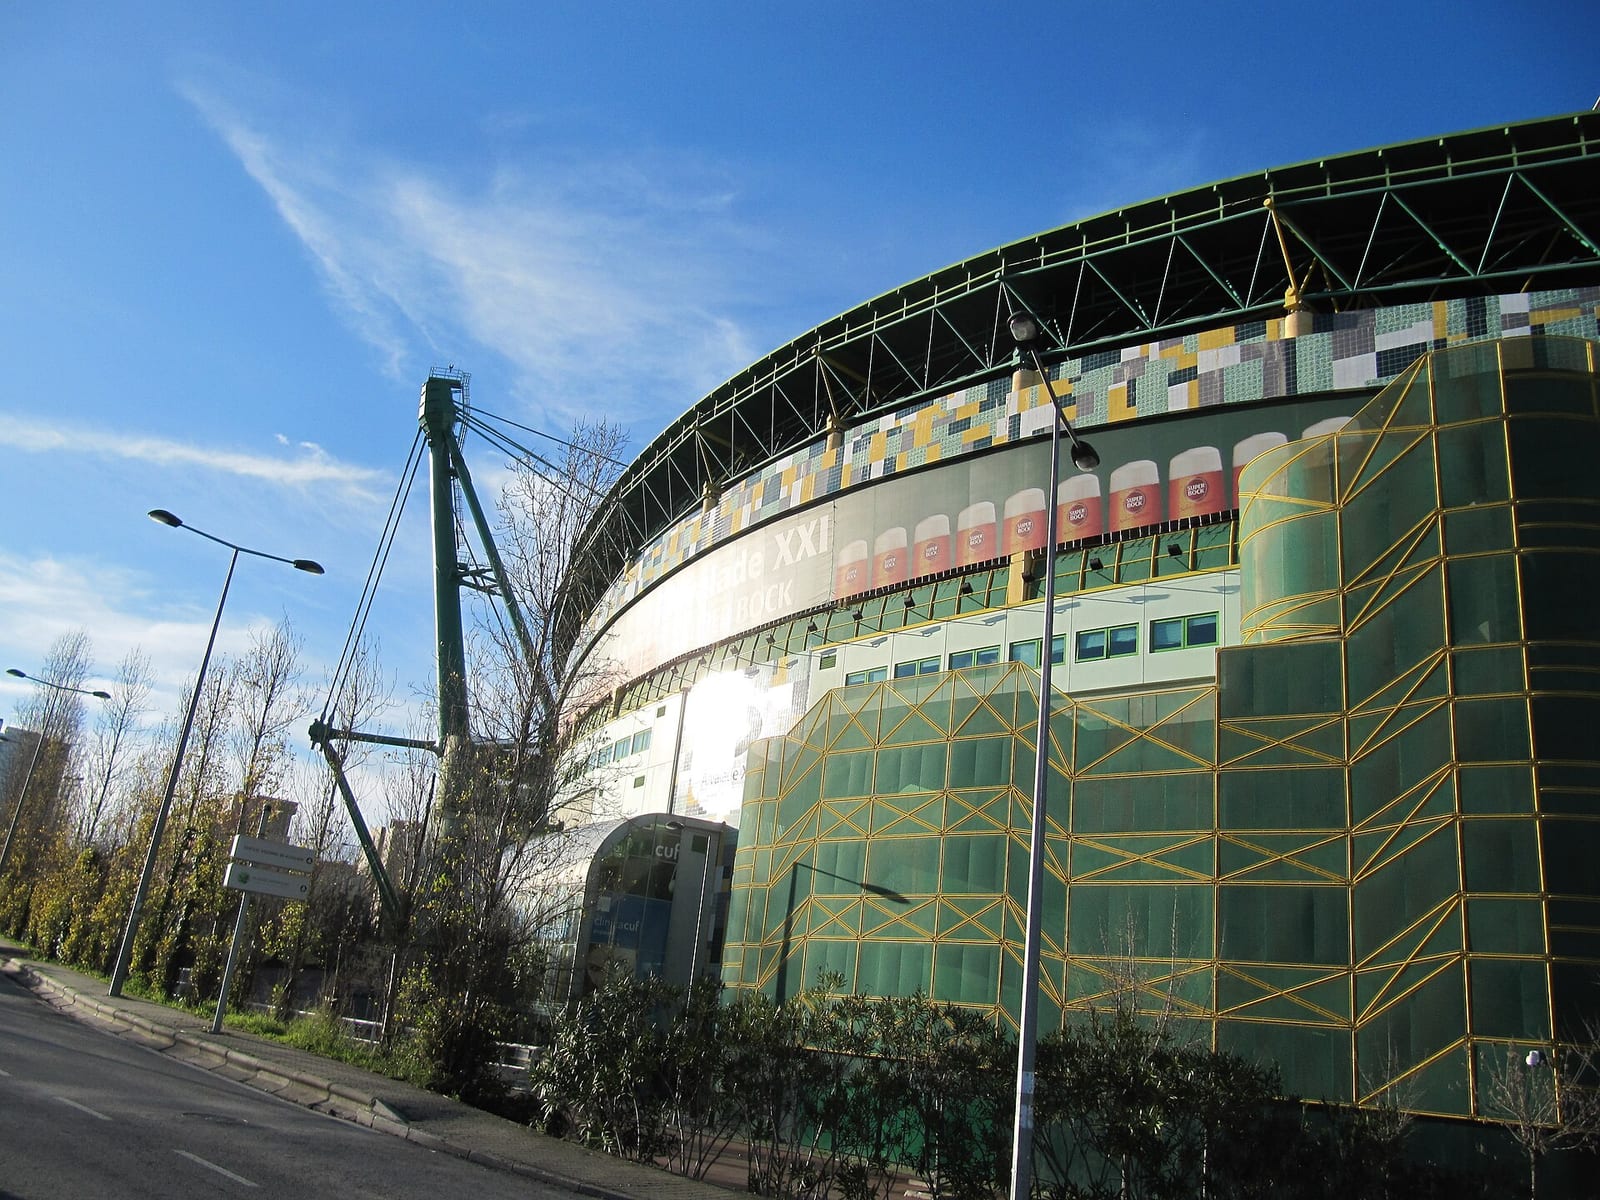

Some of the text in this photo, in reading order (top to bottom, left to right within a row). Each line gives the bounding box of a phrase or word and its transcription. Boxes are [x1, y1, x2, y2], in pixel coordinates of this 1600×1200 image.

[1187, 483, 1205, 491] SUPER
[1188, 488, 1204, 497] BOCK
[1126, 495, 1143, 503] SUPER
[1127, 501, 1143, 509] BOCK
[1069, 508, 1085, 516] SUPER
[773, 514, 830, 571] XXI
[655, 843, 680, 860] cuf
